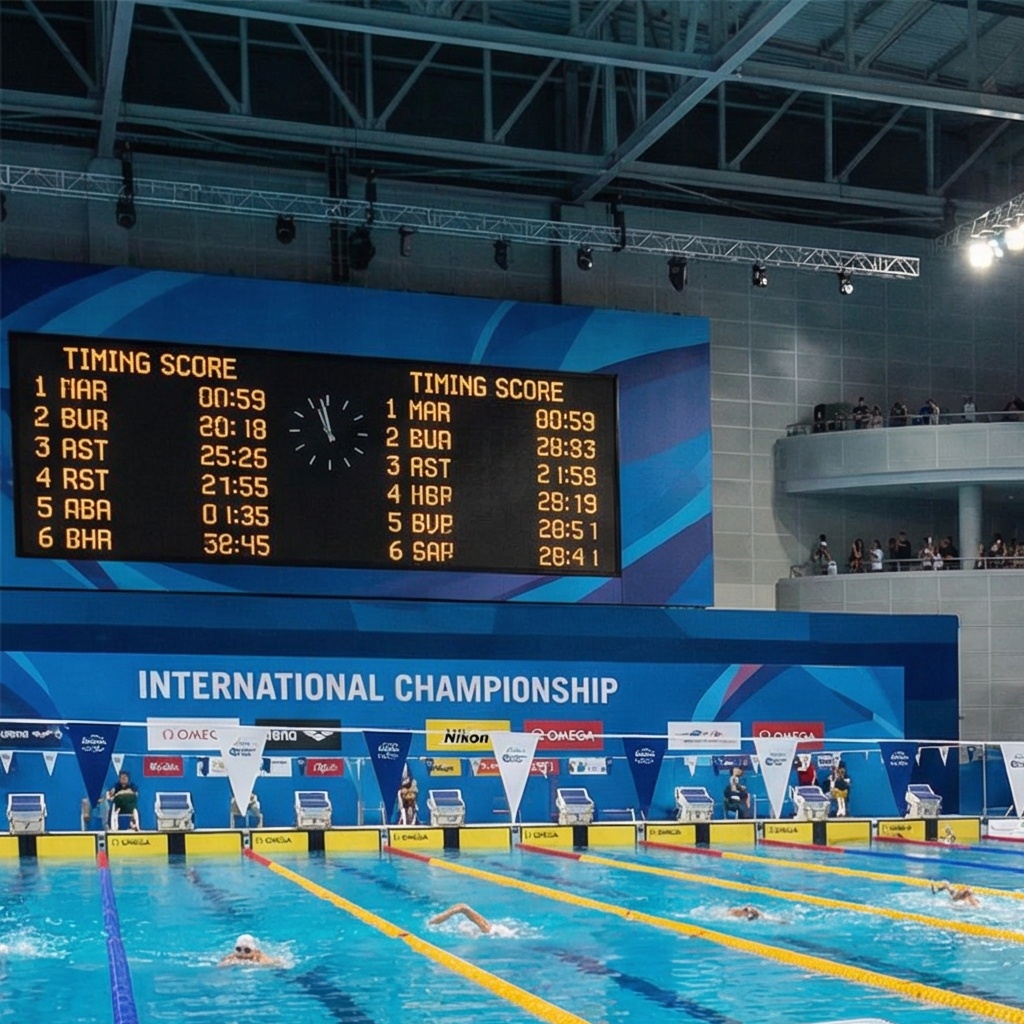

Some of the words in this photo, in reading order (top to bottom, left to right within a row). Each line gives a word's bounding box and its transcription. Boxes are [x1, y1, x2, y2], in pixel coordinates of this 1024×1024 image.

[63, 347, 151, 375] TIMING
[160, 353, 238, 380] SCORE
[35, 376, 47, 397] 1
[60, 378, 108, 402] MAR
[409, 372, 487, 397] TIMING
[495, 378, 564, 403] SCORE
[34, 406, 50, 428] 2
[61, 408, 109, 431] BUR
[386, 399, 397, 419] 1
[409, 400, 451, 423] MAR
[386, 427, 399, 447] 2
[35, 436, 51, 458] 3
[62, 438, 109, 461] AST
[201, 445, 268, 469] 25:25
[386, 455, 400, 476] 3
[36, 467, 52, 488] 4
[62, 468, 110, 491] RST
[387, 484, 401, 504] 4
[37, 496, 53, 519] 5
[64, 498, 112, 521] ABA
[388, 512, 402, 533] 5
[38, 527, 54, 549] 6
[389, 540, 403, 561] 6
[139, 670, 384, 701] INTERNATIONAL
[395, 674, 618, 704] CHAMPIONSHIP
[444, 731, 489, 744] Nikon
[547, 729, 595, 742] OMEGA
